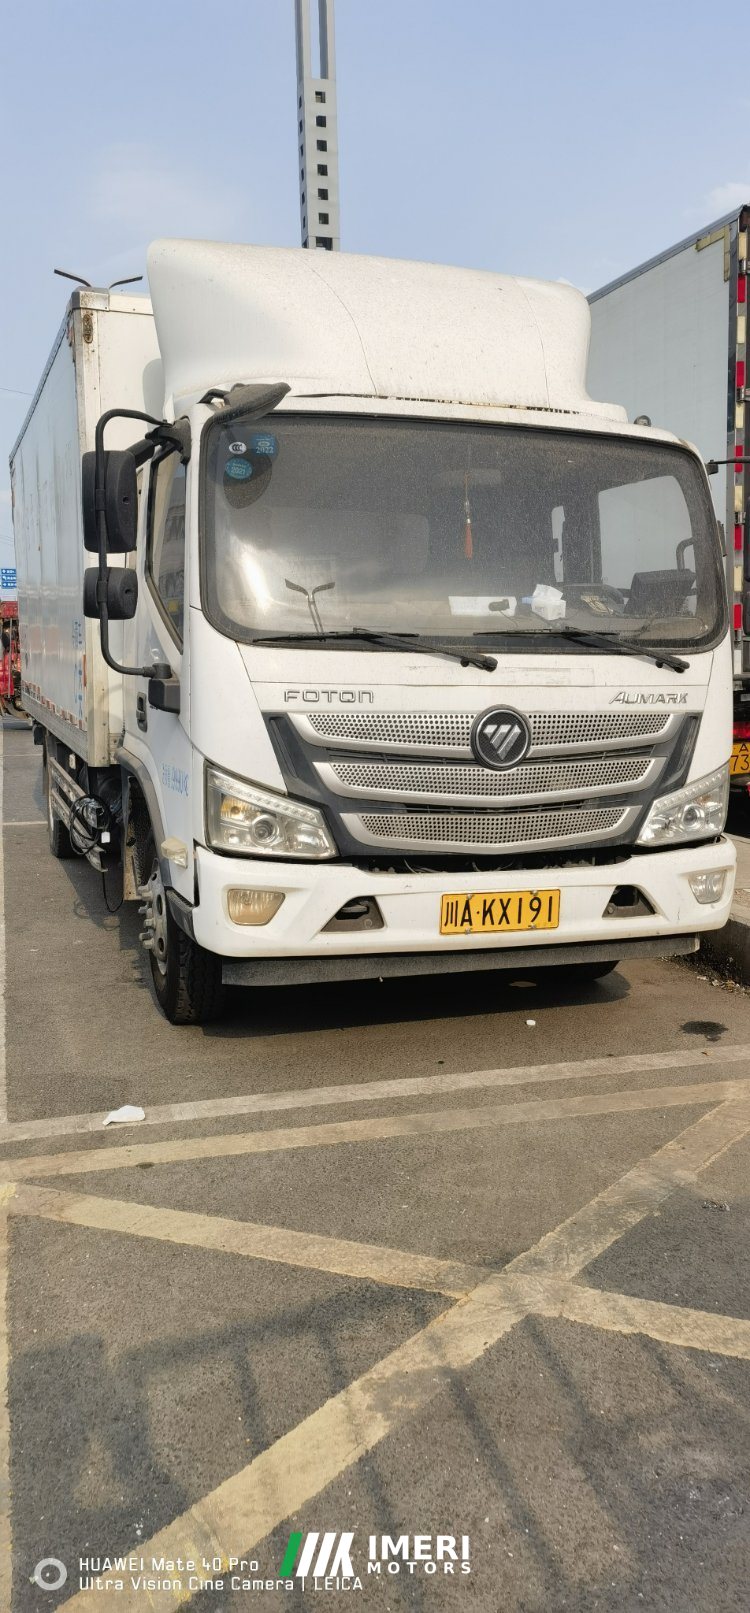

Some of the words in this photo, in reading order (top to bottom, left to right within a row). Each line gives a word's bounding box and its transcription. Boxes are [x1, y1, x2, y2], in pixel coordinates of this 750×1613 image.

[255, 446, 274, 454] 2022
[283, 689, 375, 704] FOTON
[608, 690, 689, 705] AUMARK
